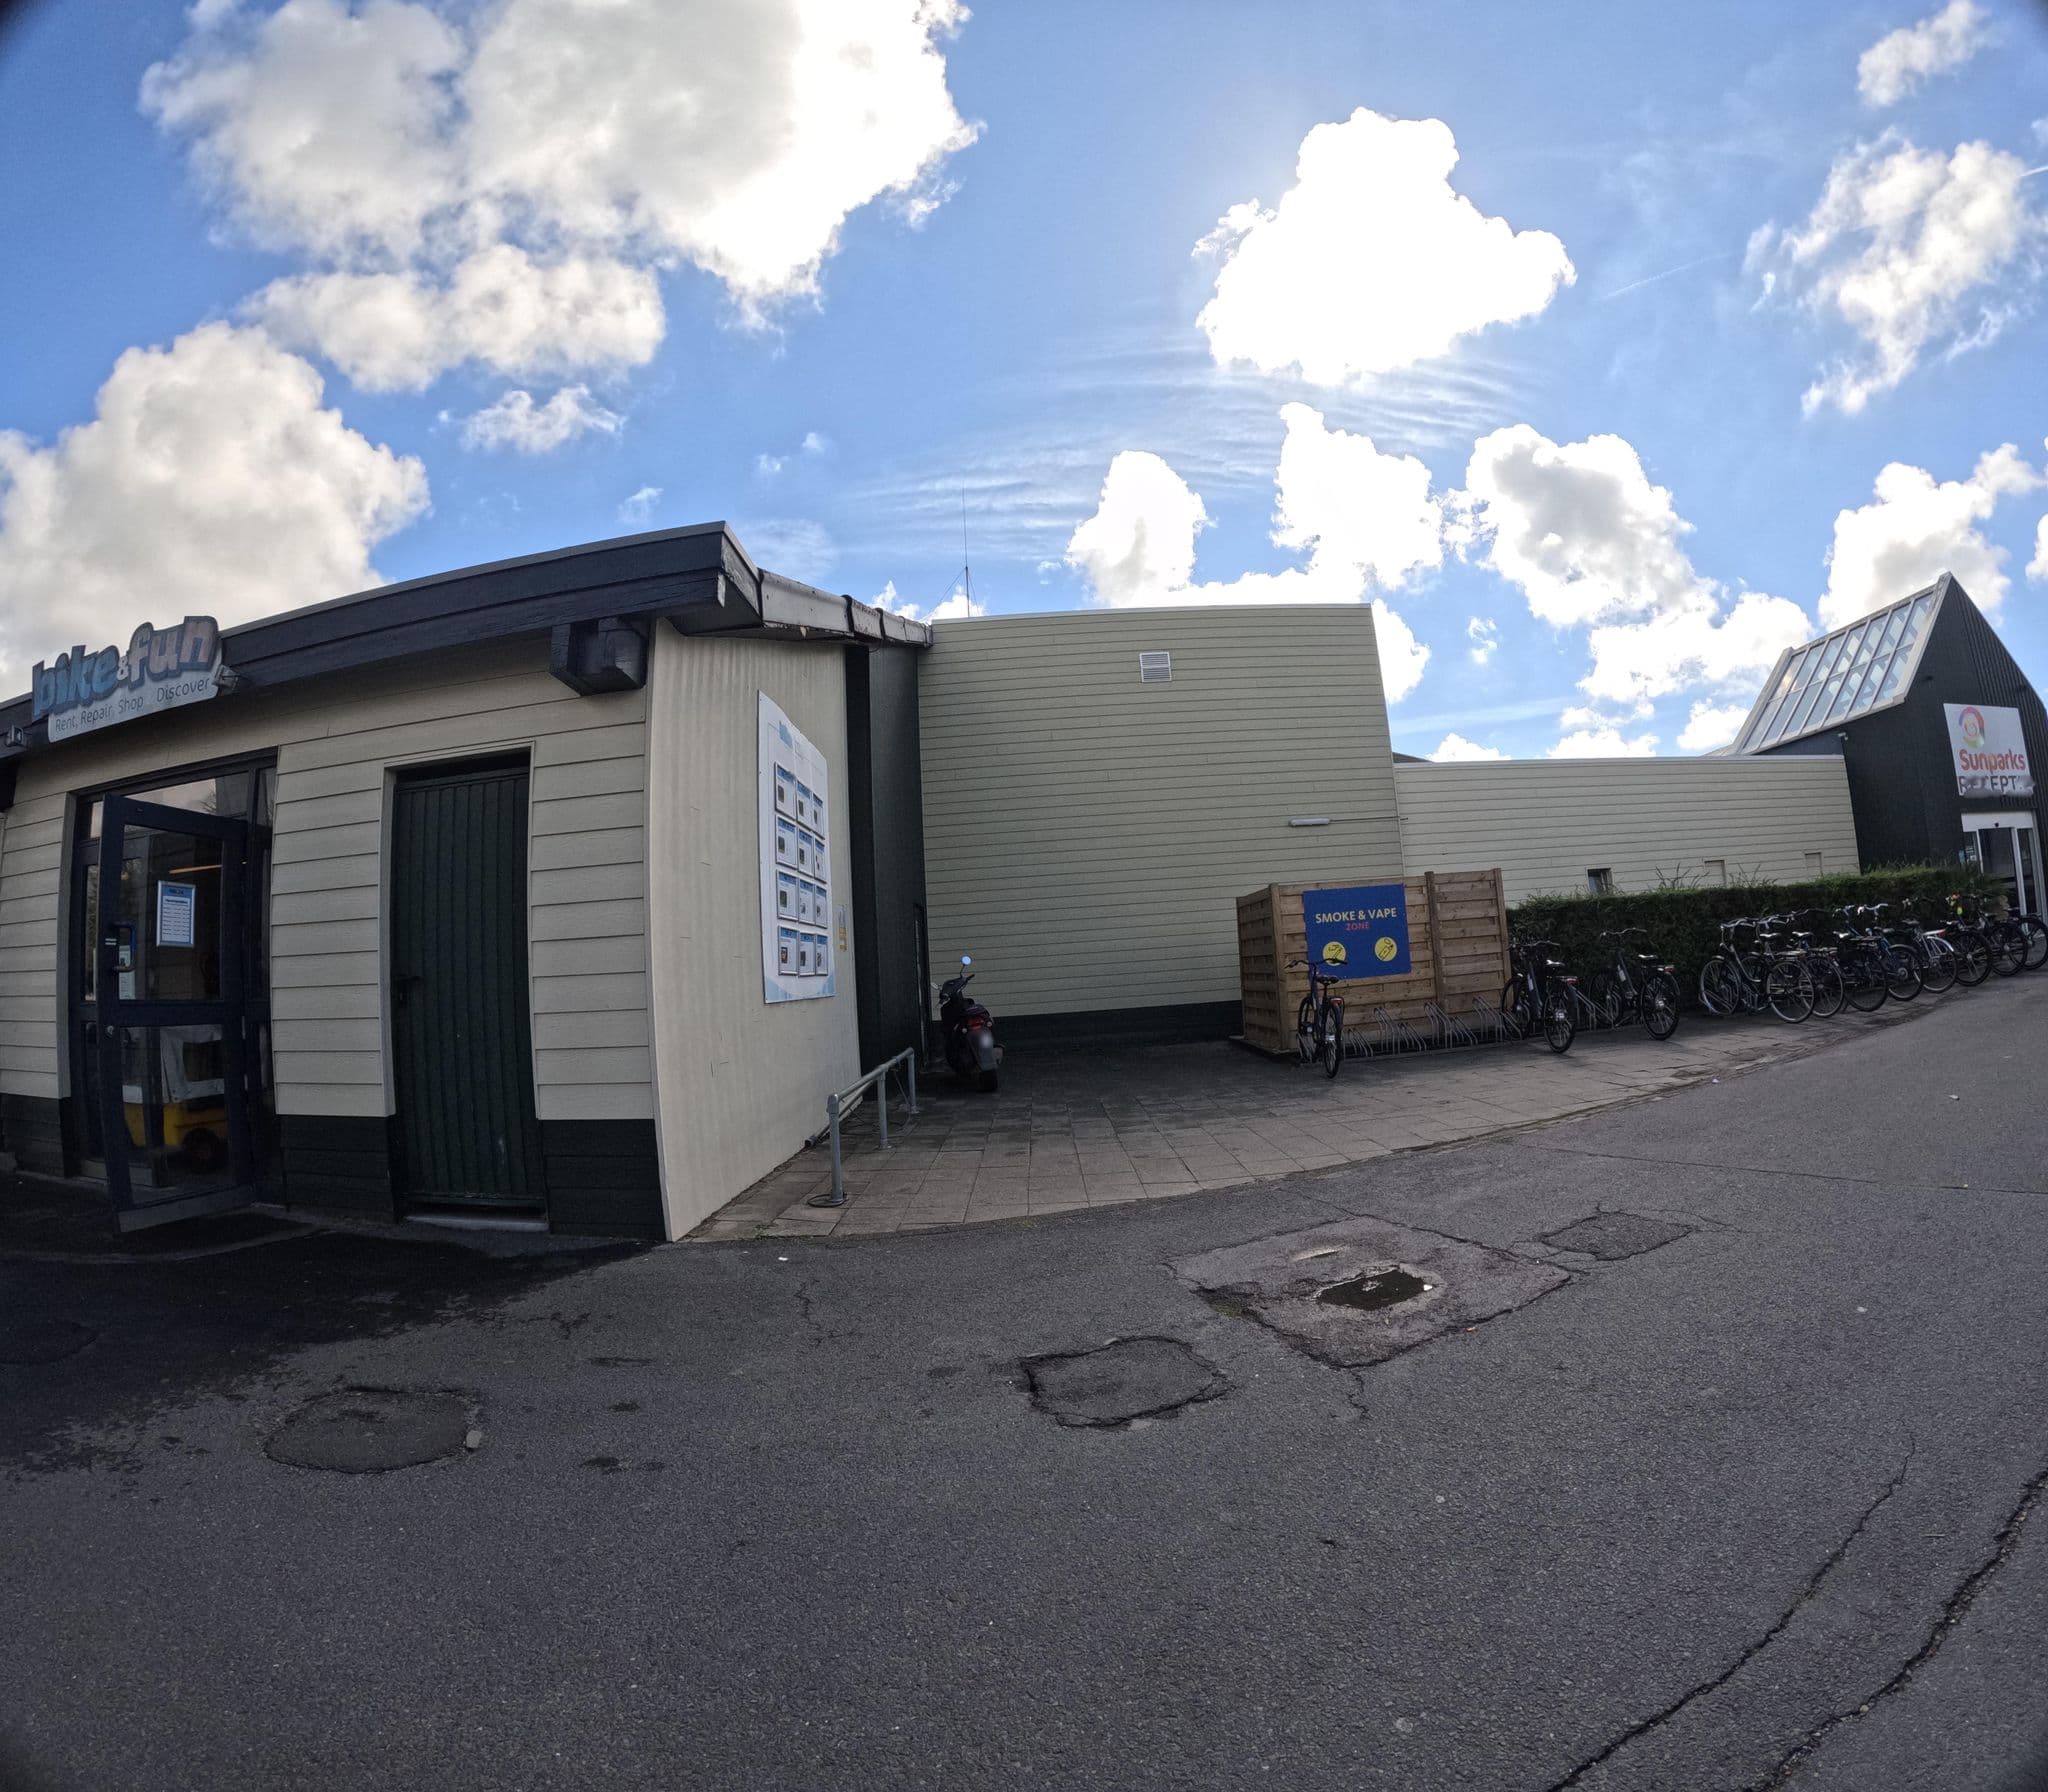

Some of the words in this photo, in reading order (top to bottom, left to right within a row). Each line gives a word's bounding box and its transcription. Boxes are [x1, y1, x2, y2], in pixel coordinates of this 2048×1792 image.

[157, 678, 210, 702] Discover
[1959, 749, 2026, 775] Sunparks
[1315, 911, 1355, 923] SMOKE
[1358, 910, 1366, 920] &
[1368, 908, 1397, 919] VAPE
[1345, 922, 1370, 931] ZONE
